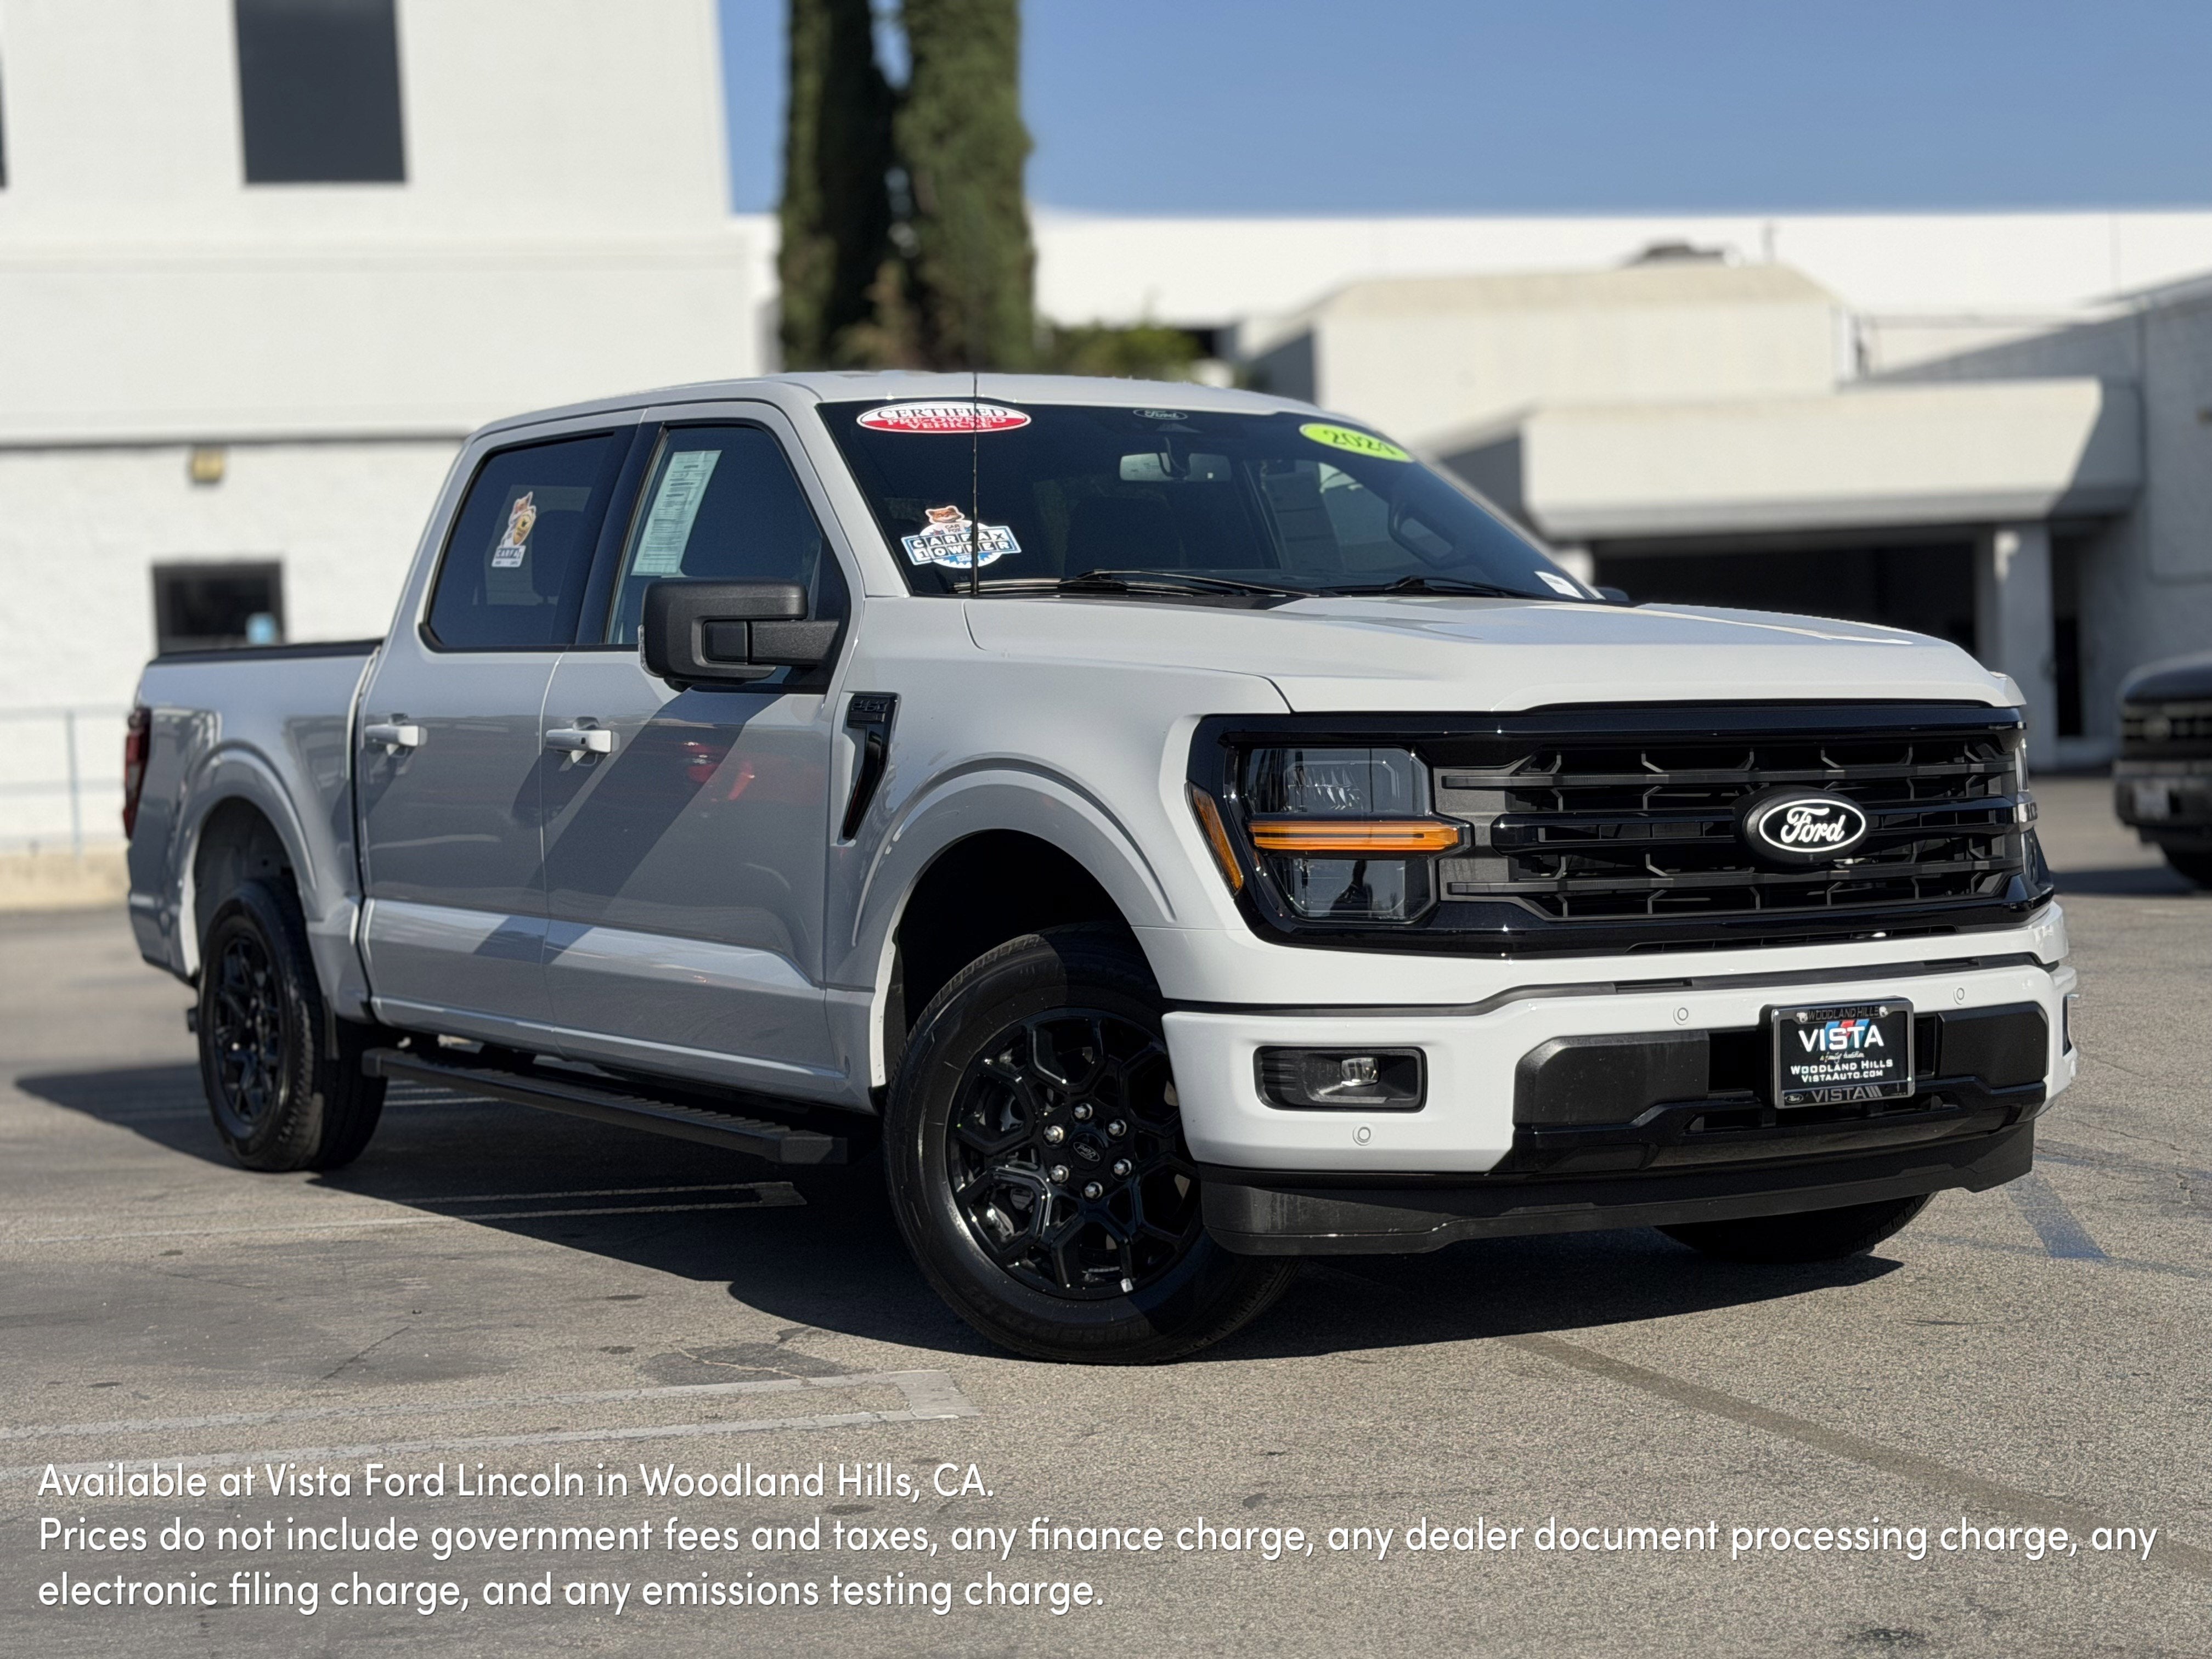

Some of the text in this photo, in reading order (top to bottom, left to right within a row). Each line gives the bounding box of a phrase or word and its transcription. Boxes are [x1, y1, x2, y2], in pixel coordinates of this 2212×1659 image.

[877, 408, 1008, 419] CERTIFIED
[912, 531, 1005, 549] CARFAX
[1781, 806, 1846, 843] Ford
[1798, 1024, 1884, 1052] VISTA
[1790, 1059, 1893, 1075] WOODLAND HILLS
[1810, 1086, 1866, 1103] VISTA
